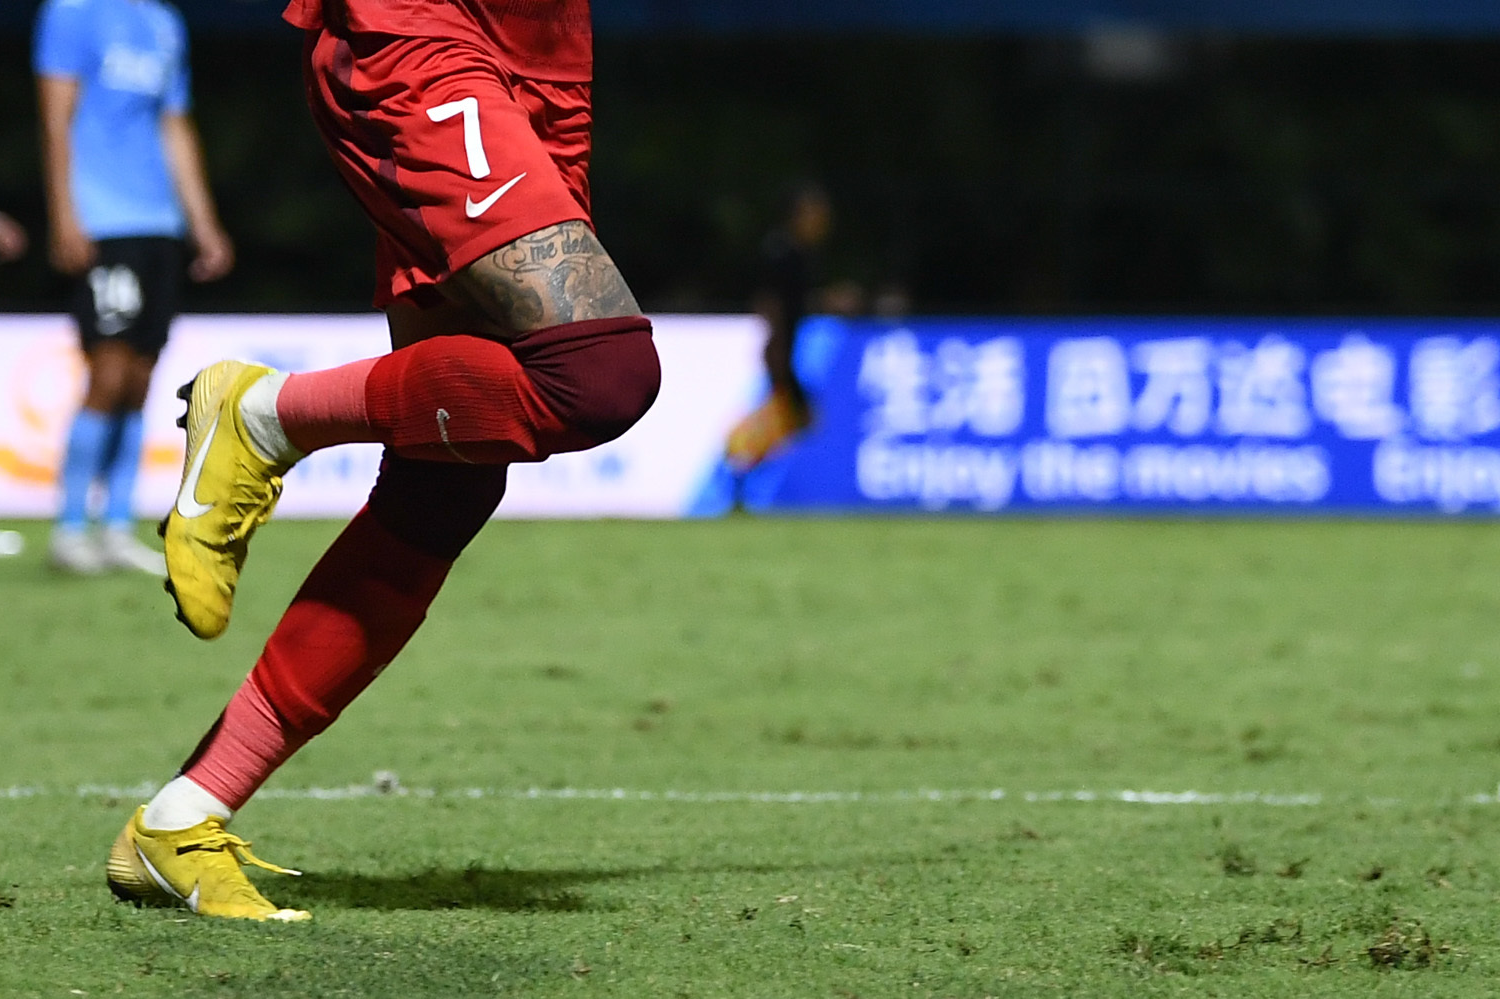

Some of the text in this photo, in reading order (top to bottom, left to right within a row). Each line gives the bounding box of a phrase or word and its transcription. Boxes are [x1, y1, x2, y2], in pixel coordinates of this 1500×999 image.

[426, 97, 491, 179] 7
[1122, 444, 1330, 501] movies
[1373, 436, 1500, 512] Enjo
